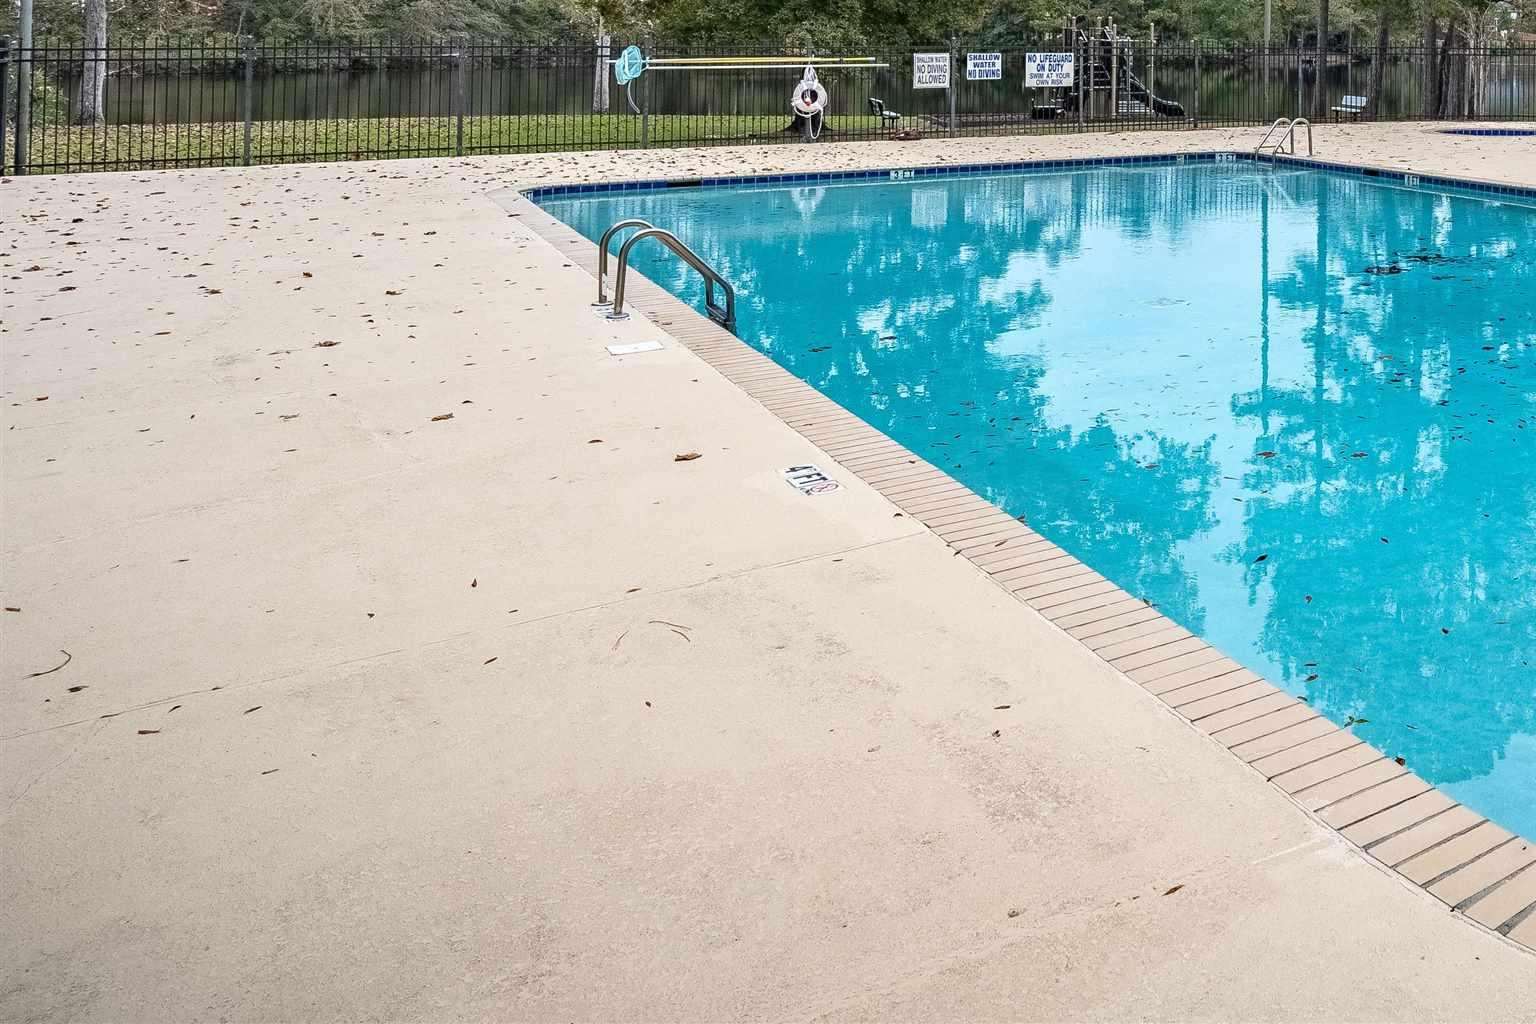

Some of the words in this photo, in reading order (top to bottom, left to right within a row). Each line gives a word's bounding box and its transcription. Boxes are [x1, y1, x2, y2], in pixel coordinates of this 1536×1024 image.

[1027, 54, 1037, 63] NO
[1039, 54, 1073, 63] LIFEGUARD
[917, 64, 926, 74] NO
[927, 64, 947, 74] DIVING
[1036, 63, 1046, 72] ON
[1048, 63, 1064, 72] DUTY
[968, 69, 977, 78] NO
[978, 69, 1000, 78] DIVING
[1029, 72, 1044, 80] SWIM
[917, 74, 946, 84] ALLOWED
